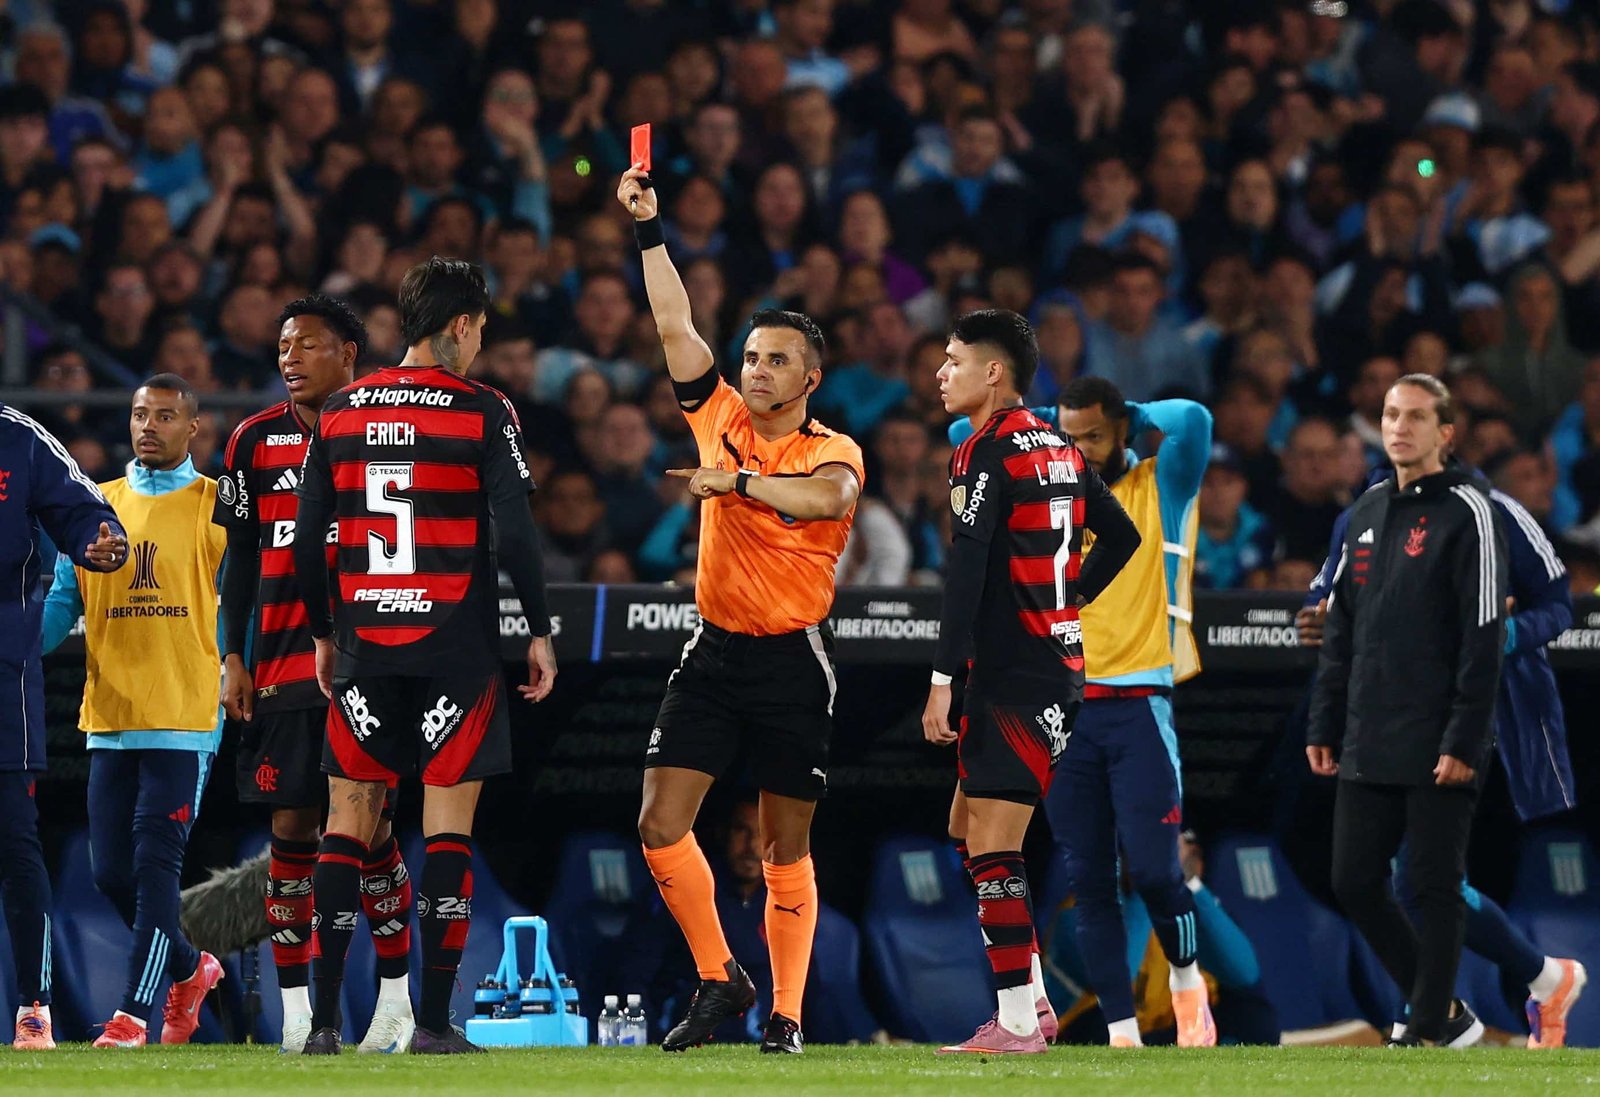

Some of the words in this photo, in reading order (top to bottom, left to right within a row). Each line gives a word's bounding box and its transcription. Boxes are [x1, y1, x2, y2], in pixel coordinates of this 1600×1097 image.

[370, 388, 454, 407] Hapvida
[278, 433, 303, 445] BRB
[366, 422, 415, 446] ERICK
[503, 424, 530, 479] Shopee
[961, 472, 989, 526] Shopee
[365, 461, 417, 575] 5
[1049, 495, 1074, 611] 7
[129, 595, 159, 604] CONMEBOL
[353, 588, 427, 601] ASSIST
[106, 606, 188, 619] LBERTADORES
[376, 600, 433, 613] CARD
[627, 603, 698, 630] POWE
[1247, 609, 1288, 624] CONMEBOL
[1050, 619, 1081, 636] ASSIS
[1207, 626, 1298, 647] LIBERTADO
[340, 696, 347, 706] da
[344, 705, 365, 742] construção
[346, 685, 381, 737] abc
[421, 695, 458, 743] abc
[431, 741, 439, 751] da
[436, 708, 464, 743] construção
[279, 876, 312, 894] Zé
[977, 880, 1005, 896] Zé
[436, 897, 467, 914] Zé
